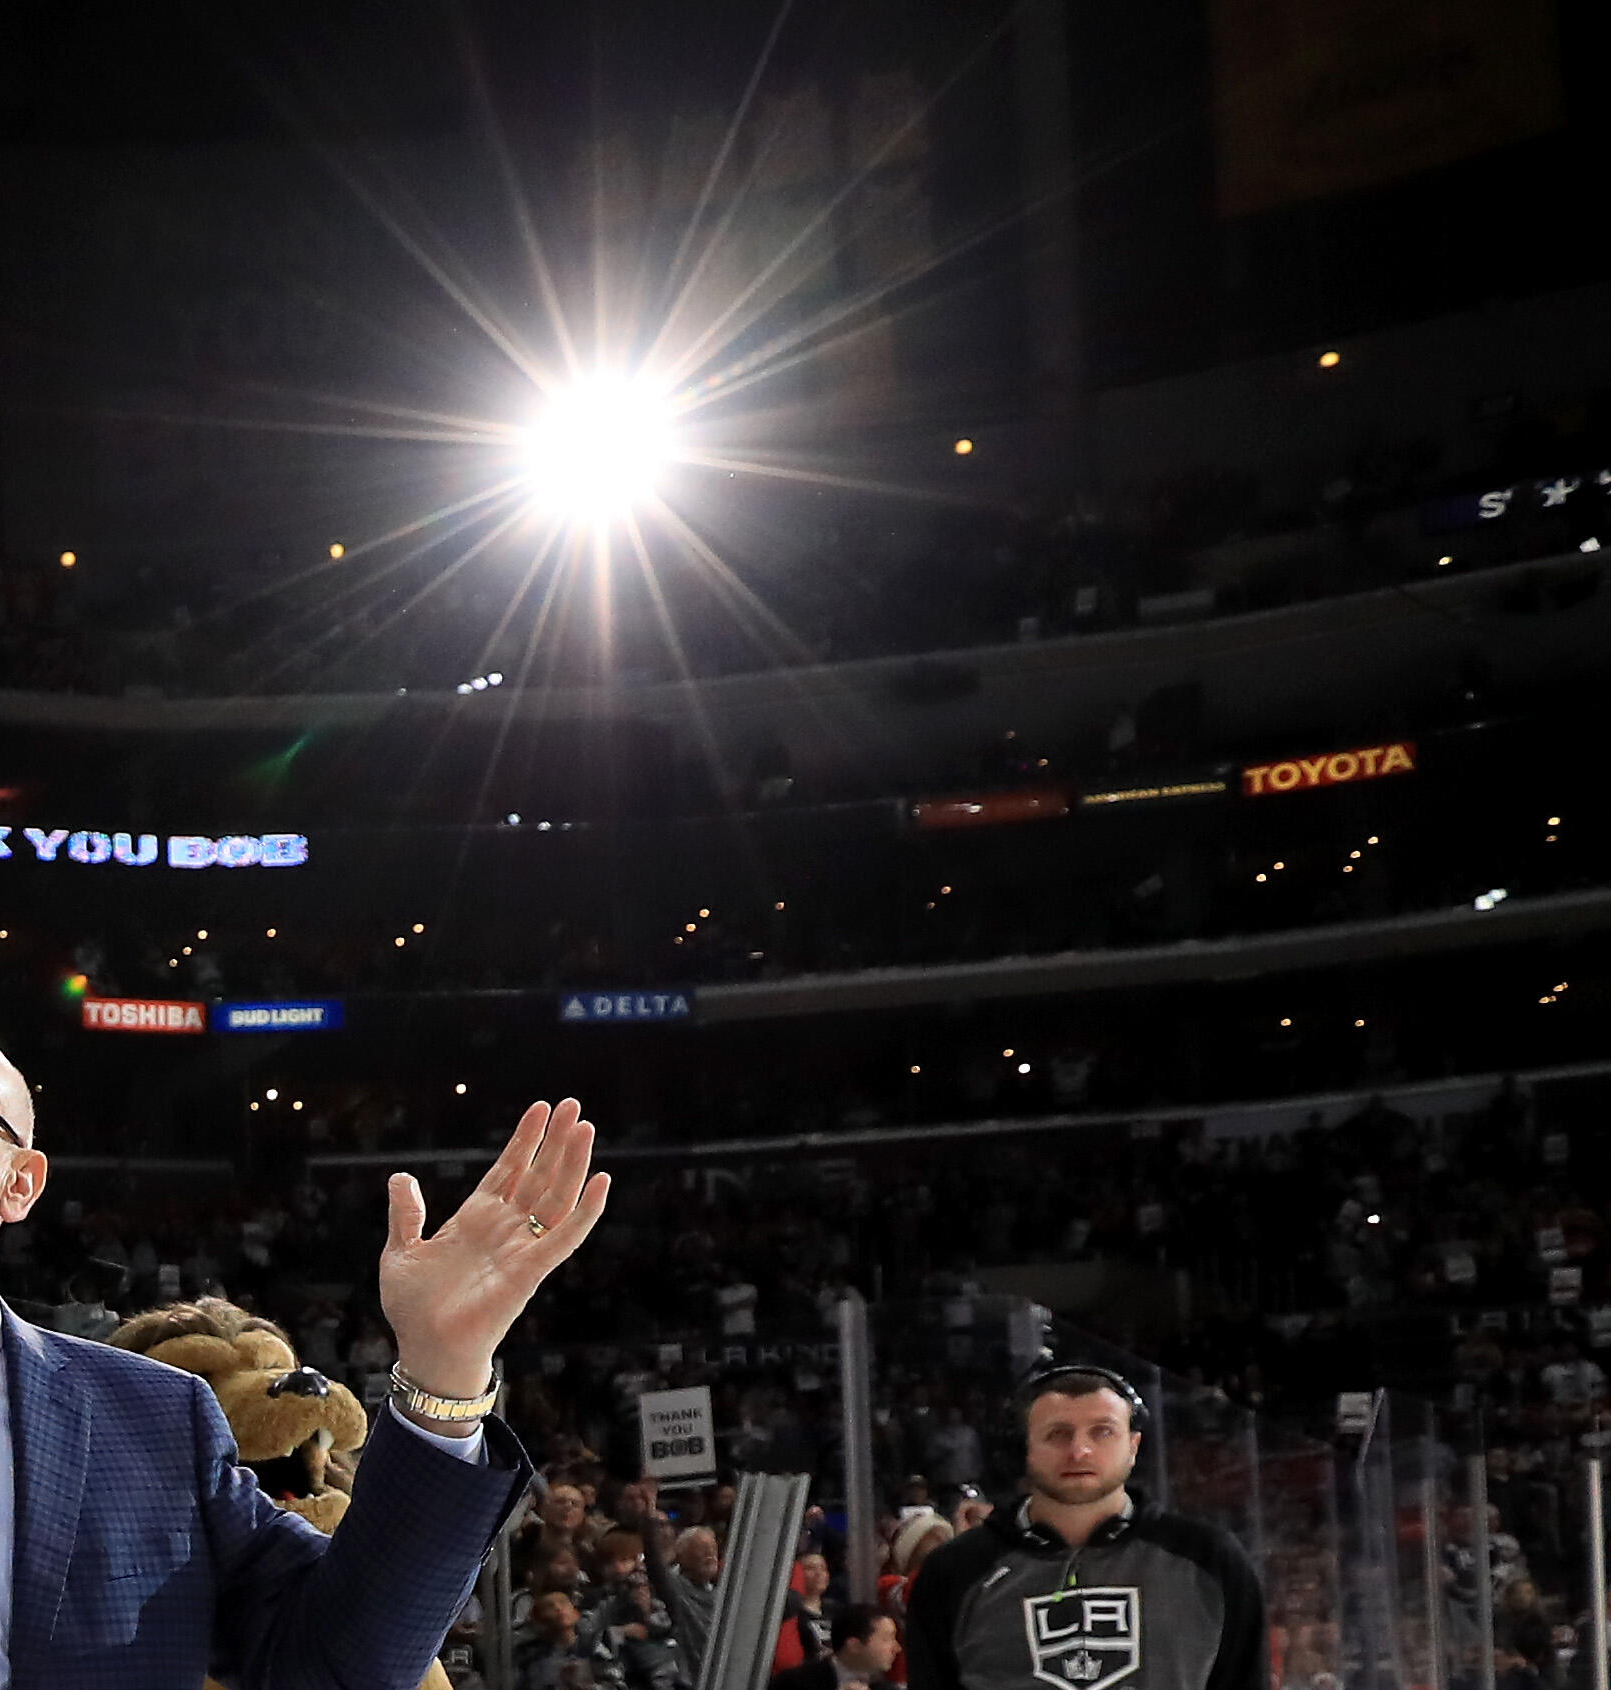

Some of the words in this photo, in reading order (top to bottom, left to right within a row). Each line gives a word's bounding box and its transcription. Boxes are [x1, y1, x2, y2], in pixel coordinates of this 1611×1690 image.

[1242, 744, 1415, 794] TOYOTA
[23, 827, 158, 867] YOU
[167, 832, 309, 870] BOB
[83, 1001, 204, 1029] TOSHIBA
[230, 1009, 270, 1028] BUD
[271, 1007, 325, 1025] LIGHT
[594, 993, 689, 1017] DELTA
[649, 1407, 703, 1424] THANK
[662, 1422, 694, 1436] YOU
[651, 1435, 706, 1460] BOB
[1036, 1599, 1129, 1641] LA
